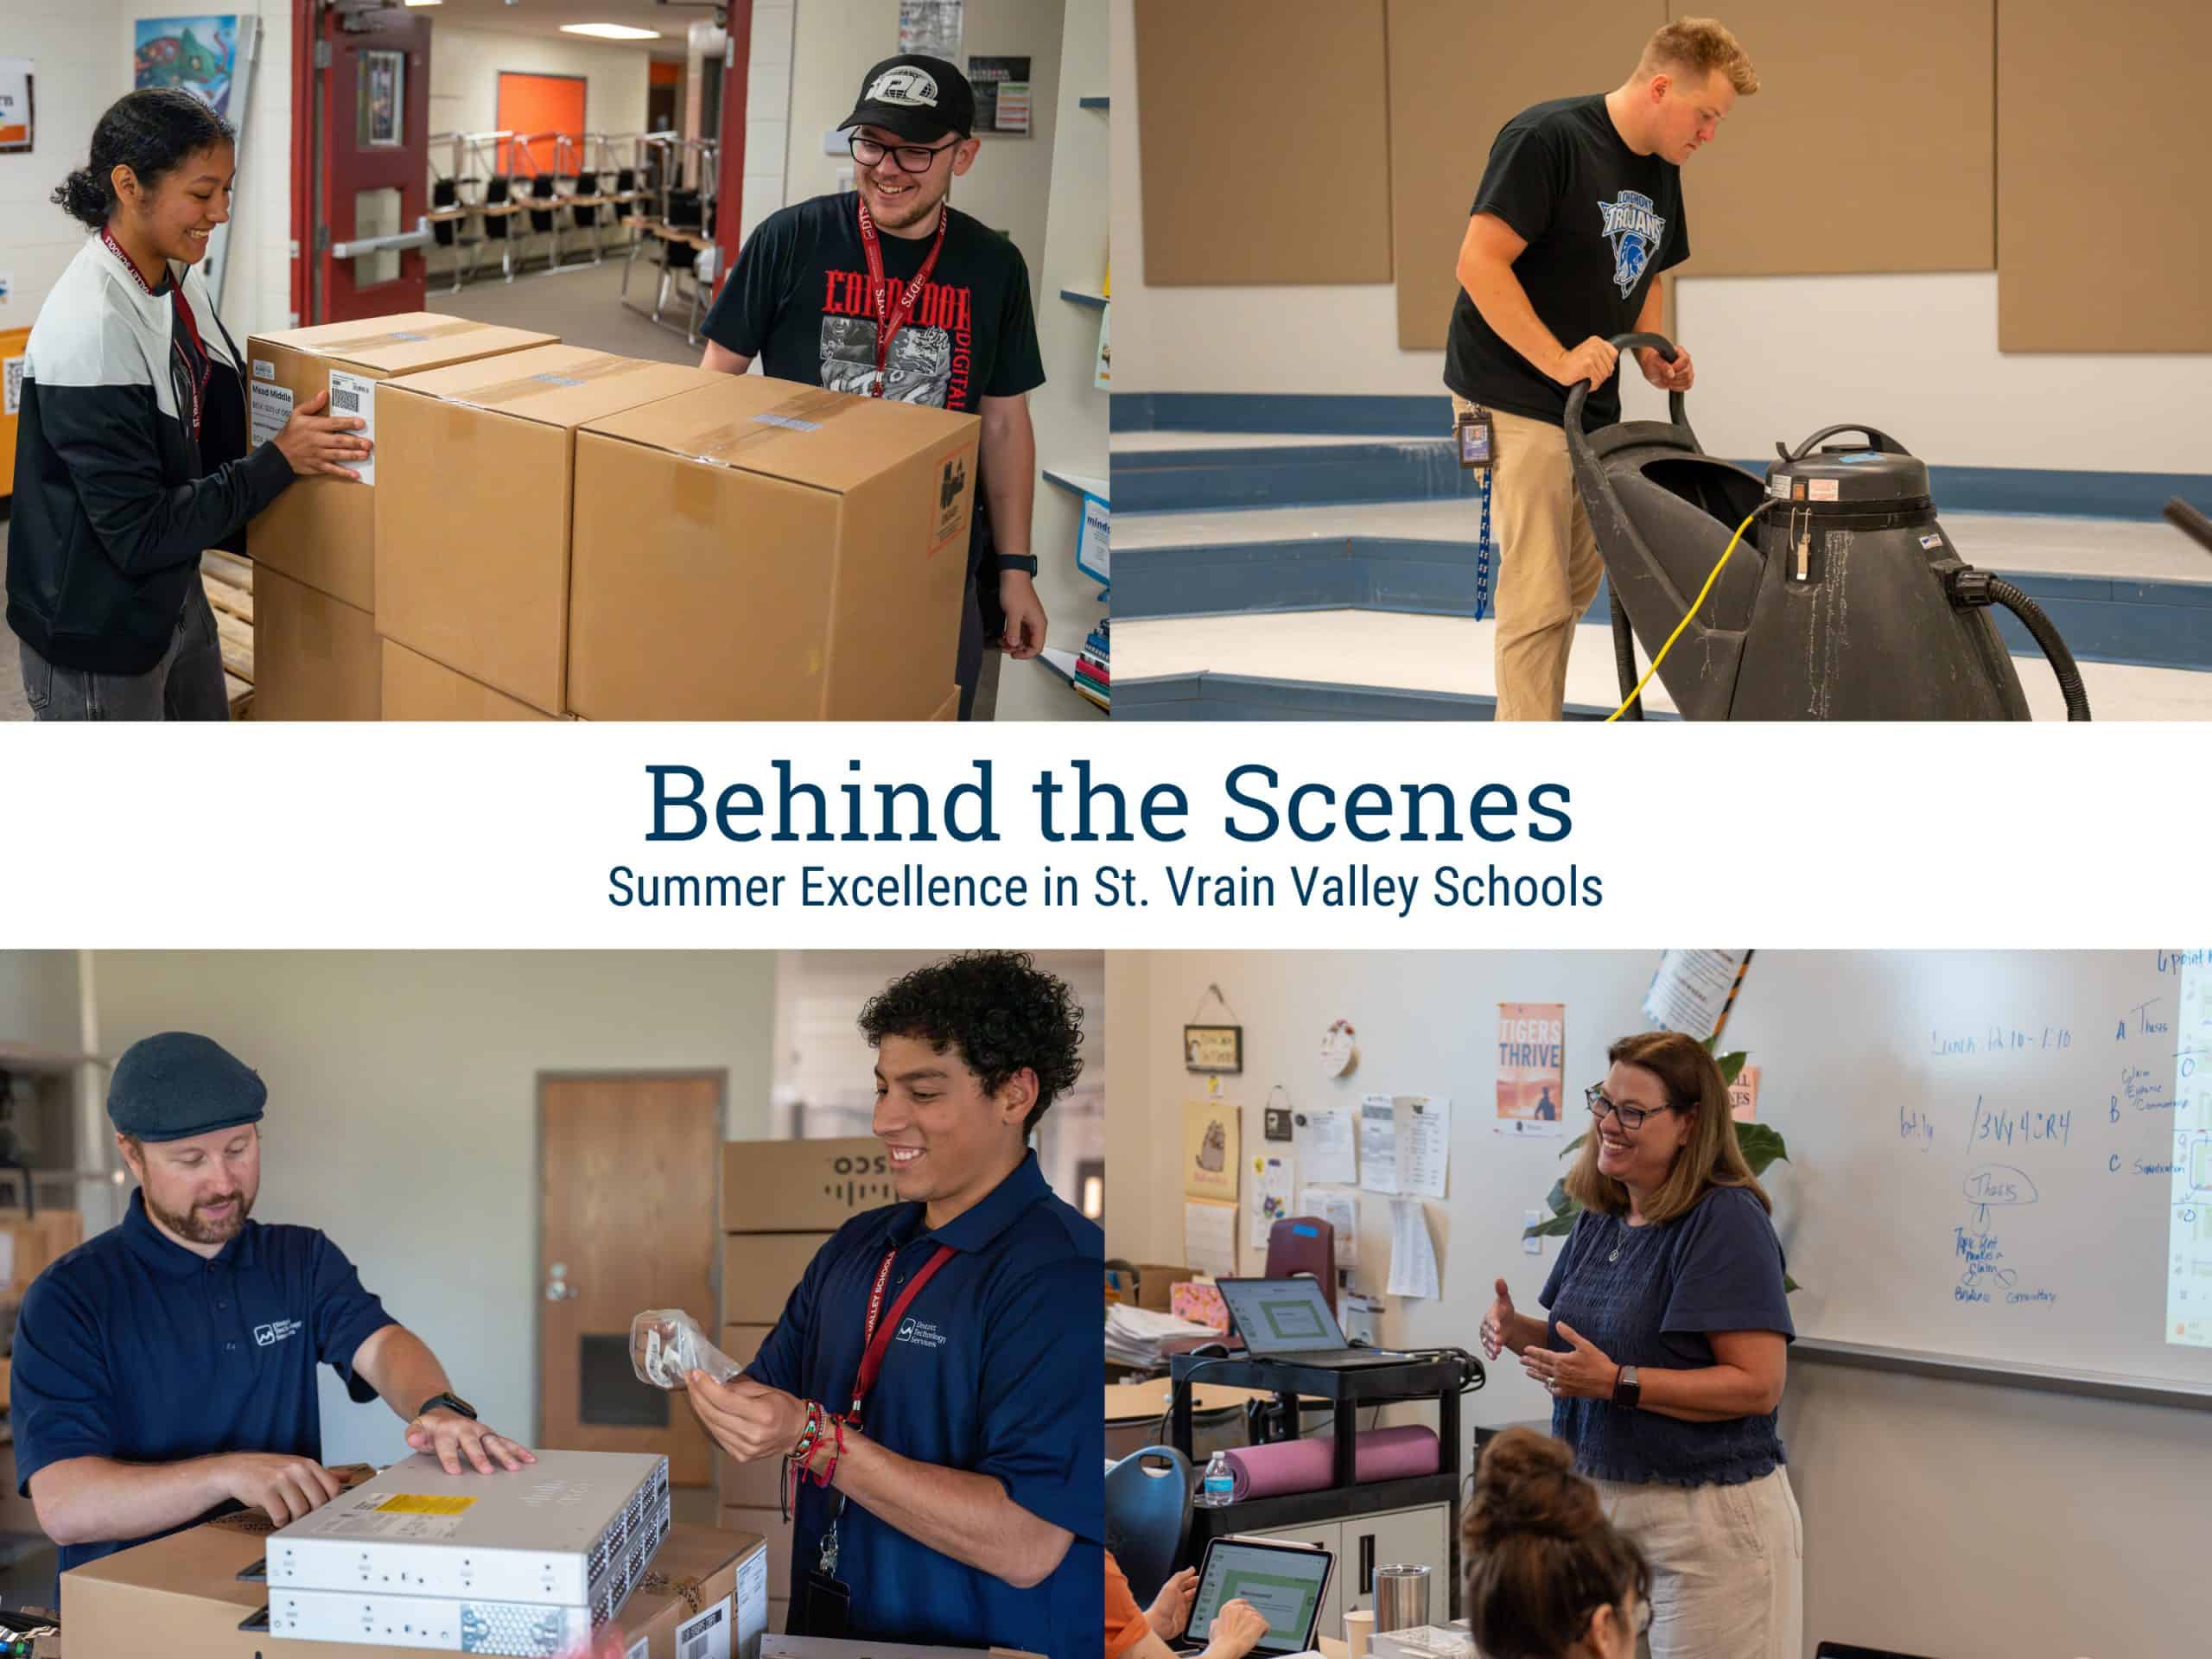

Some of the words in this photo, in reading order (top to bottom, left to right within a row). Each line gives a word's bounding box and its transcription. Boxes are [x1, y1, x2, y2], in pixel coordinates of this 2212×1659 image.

[1604, 207, 1661, 244] TROJANS
[947, 331, 972, 410] DIGITAL
[270, 390, 292, 403] Middle
[2171, 949, 2203, 975] point
[1499, 1020, 1560, 1043] TIGERS
[2115, 1020, 2126, 1040] A
[1500, 1043, 1562, 1068] THRIVE
[2110, 1096, 2120, 1123] B
[2109, 1154, 2121, 1172] C
[1970, 1173, 2018, 1202] Thesis
[868, 1294, 880, 1332] VALLEY
[874, 1250, 896, 1294] SCHOOLS
